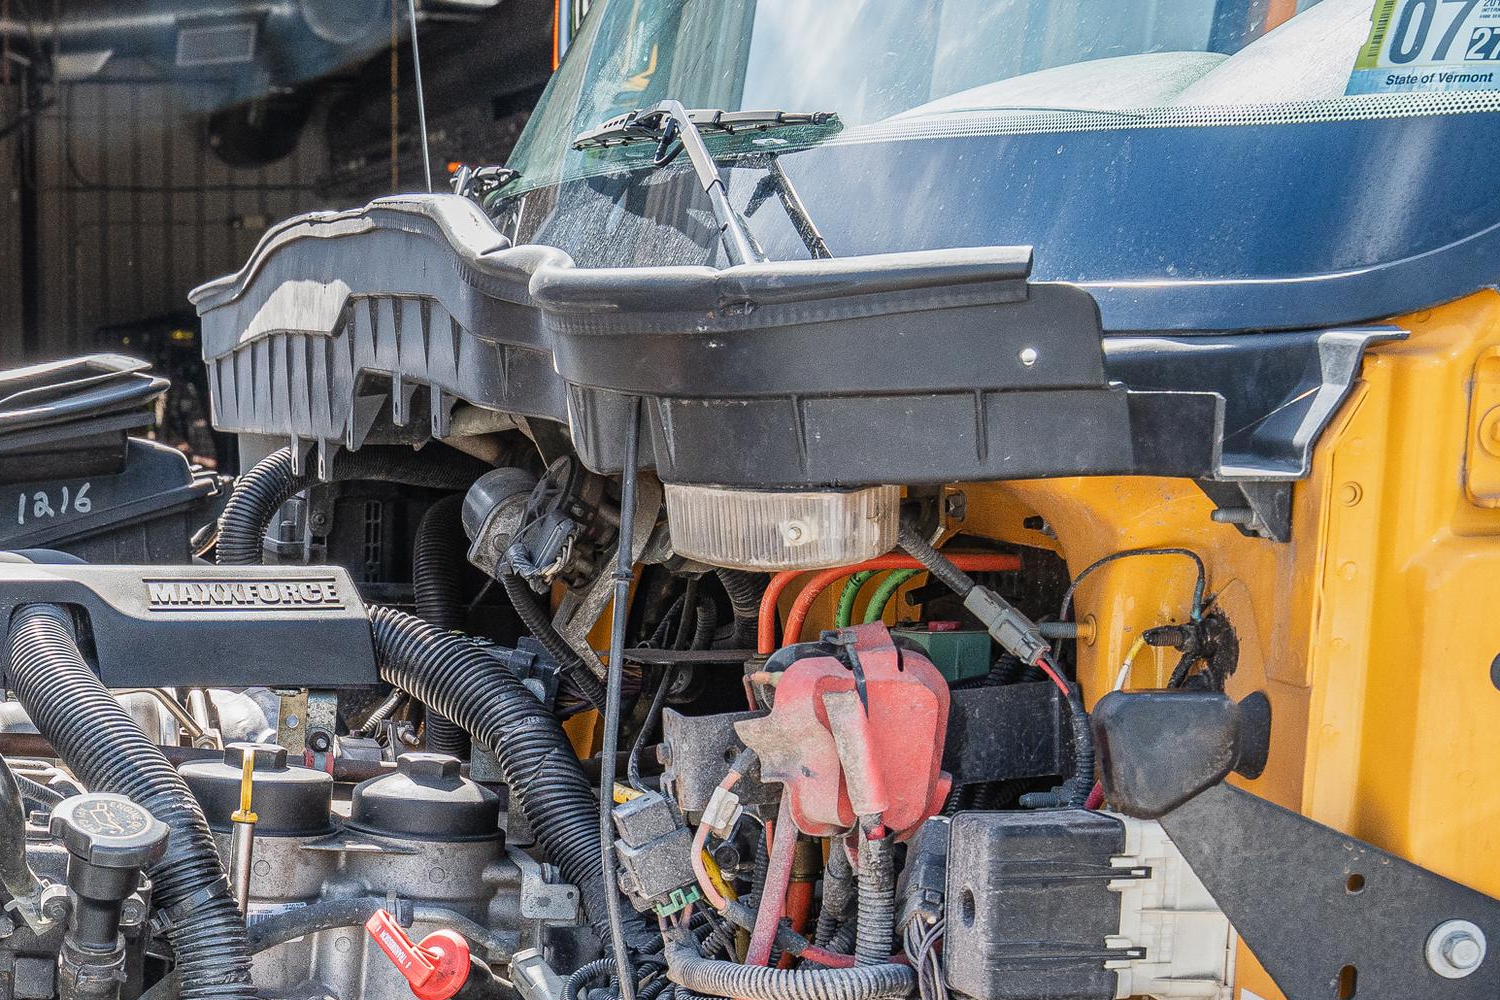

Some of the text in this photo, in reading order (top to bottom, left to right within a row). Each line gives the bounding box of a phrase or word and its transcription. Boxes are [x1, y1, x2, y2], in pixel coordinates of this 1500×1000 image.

[1389, 0, 1479, 64] 07
[1386, 72, 1493, 85] State of Vermont
[18, 482, 91, 525] 1216
[149, 582, 341, 606] MAXXFORCE
